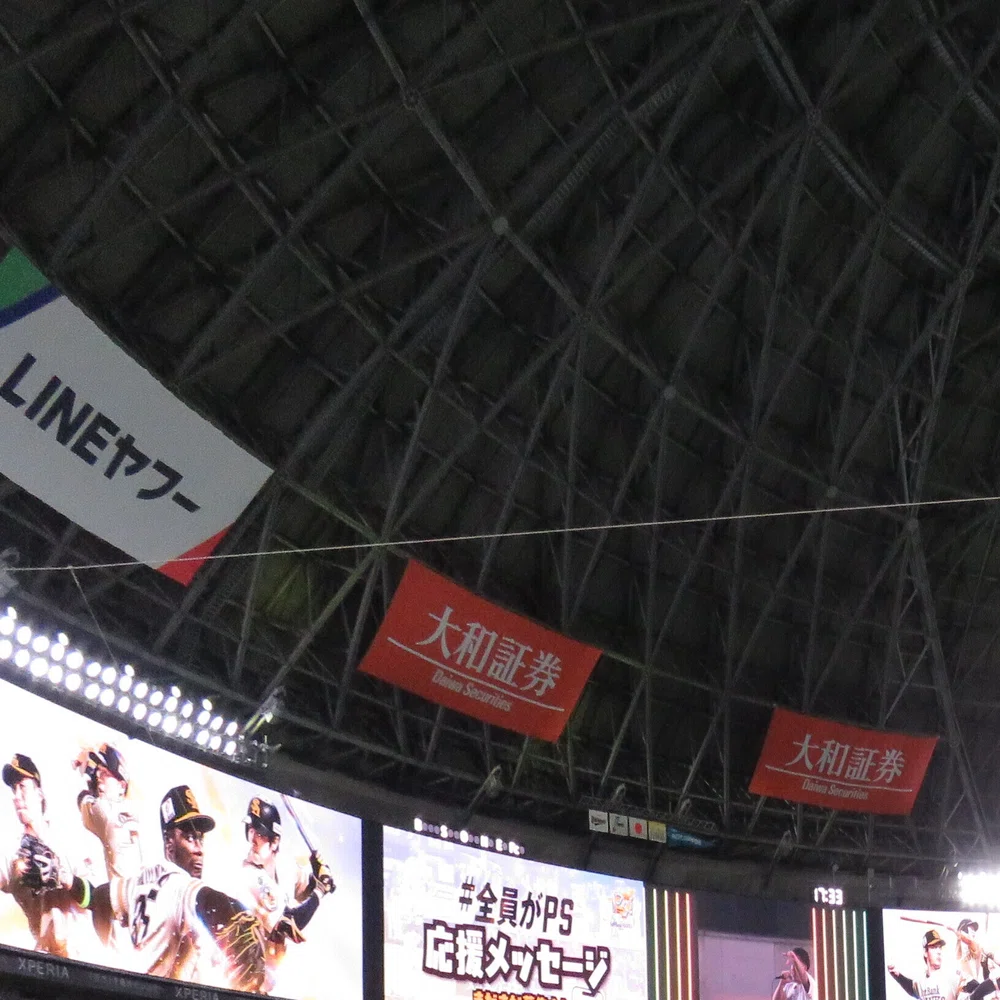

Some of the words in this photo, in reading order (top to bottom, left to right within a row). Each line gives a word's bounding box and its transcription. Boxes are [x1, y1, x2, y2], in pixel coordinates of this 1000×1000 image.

[0, 353, 201, 514] LINEヤフー
[416, 605, 562, 696] 大和証券
[432, 668, 462, 692] Daiwa
[463, 682, 512, 712] Securities
[785, 733, 905, 784] 大和証券
[802, 777, 828, 797] Daiwa
[828, 784, 869, 801] Securities
[459, 876, 575, 936] #全員がPS
[814, 887, 843, 905] 17:33
[18, 957, 69, 978] XPERIA
[422, 919, 612, 997] 応援メッセージ
